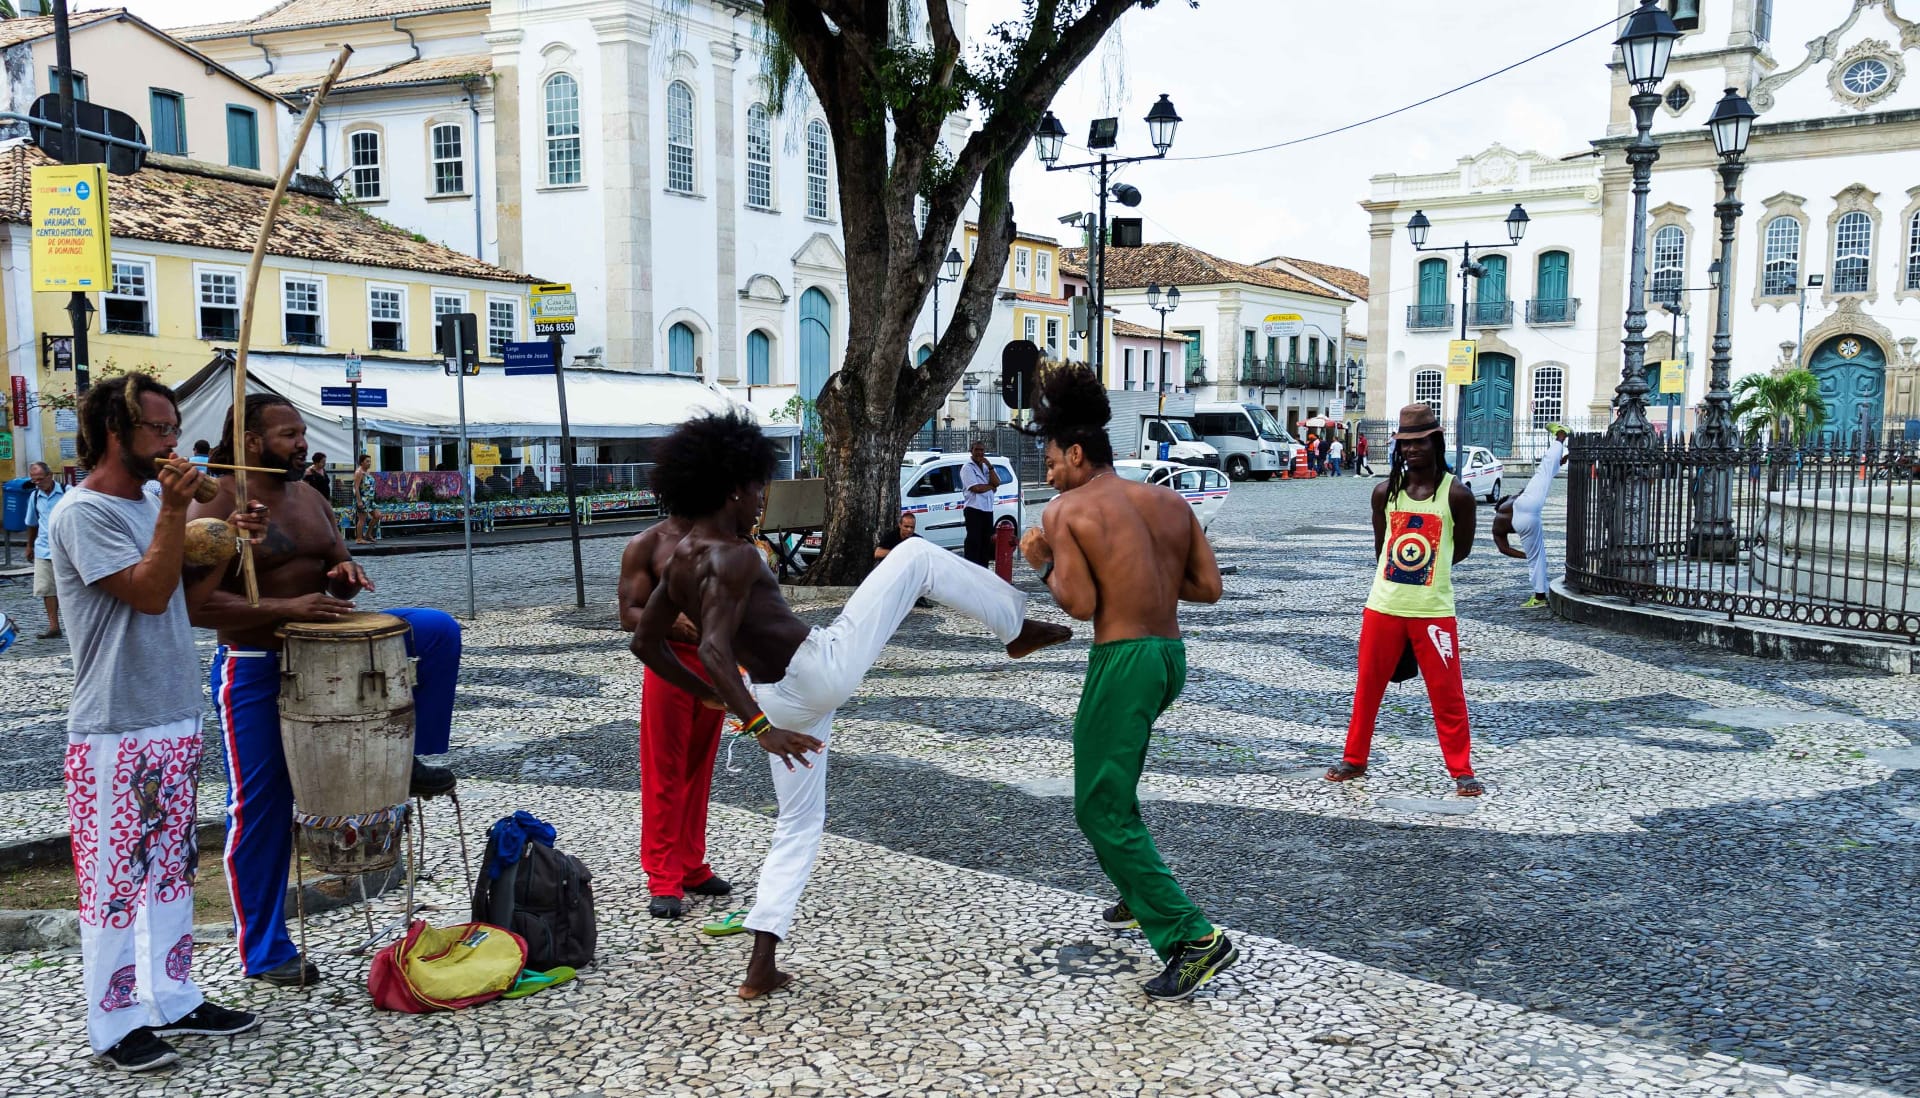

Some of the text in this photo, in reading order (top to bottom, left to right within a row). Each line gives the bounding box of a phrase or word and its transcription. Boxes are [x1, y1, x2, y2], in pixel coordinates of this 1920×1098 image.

[49, 207, 80, 217] ATRAÇÕES
[78, 218, 86, 226] NO
[36, 228, 60, 237] CENTRO
[48, 238, 85, 246] DE DOMINGO
[536, 323, 575, 333] 3266 8550
[1438, 630, 1454, 659] NIKE
